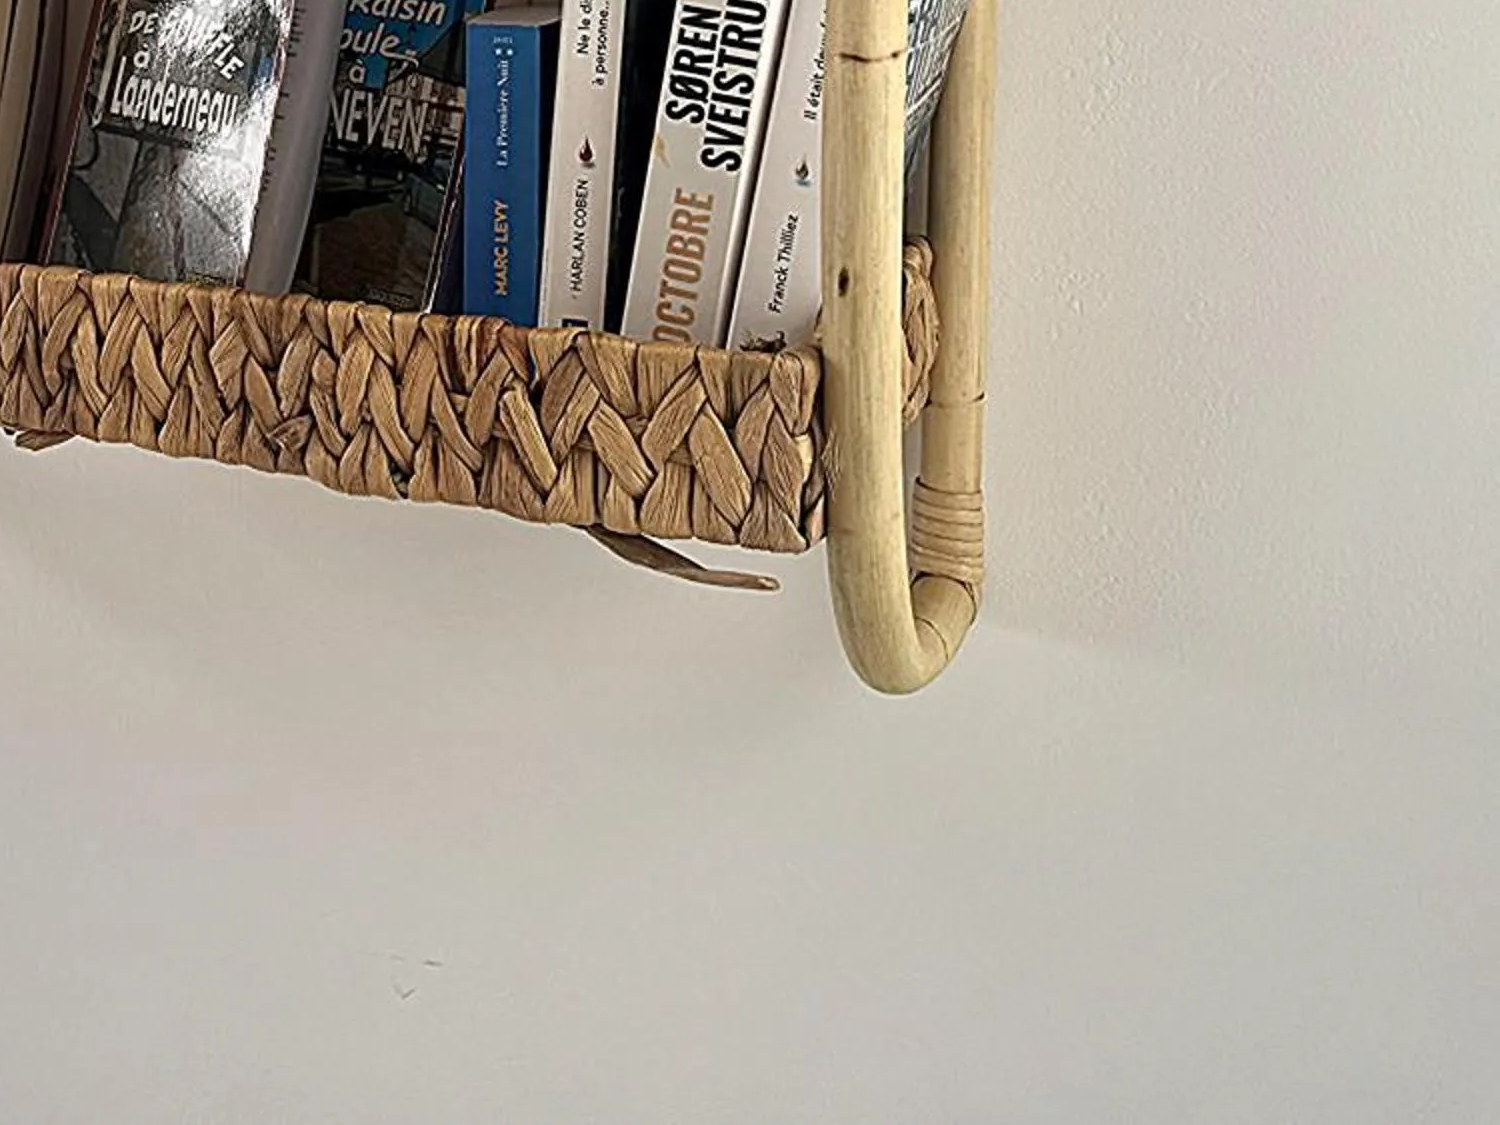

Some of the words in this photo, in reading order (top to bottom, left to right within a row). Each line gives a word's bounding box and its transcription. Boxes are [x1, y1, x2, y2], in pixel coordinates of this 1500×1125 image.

[128, 12, 158, 35] DE
[339, 23, 402, 58] oule
[577, 35, 590, 54] Ne
[578, 18, 592, 32] le
[132, 44, 151, 69] à
[349, 59, 366, 85] à
[665, 4, 722, 124] SØREN
[109, 55, 240, 137] Landerneau
[592, 75, 604, 87] à
[330, 88, 429, 156] NEVEN
[496, 150, 509, 167] La
[494, 200, 510, 245] LEVY
[574, 178, 589, 228] COBEN
[569, 230, 586, 292] HARLAN
[778, 213, 800, 263] Thilliez
[494, 246, 509, 296] MARC
[653, 187, 715, 342] OCTOBRE
[768, 265, 789, 313] Franck
